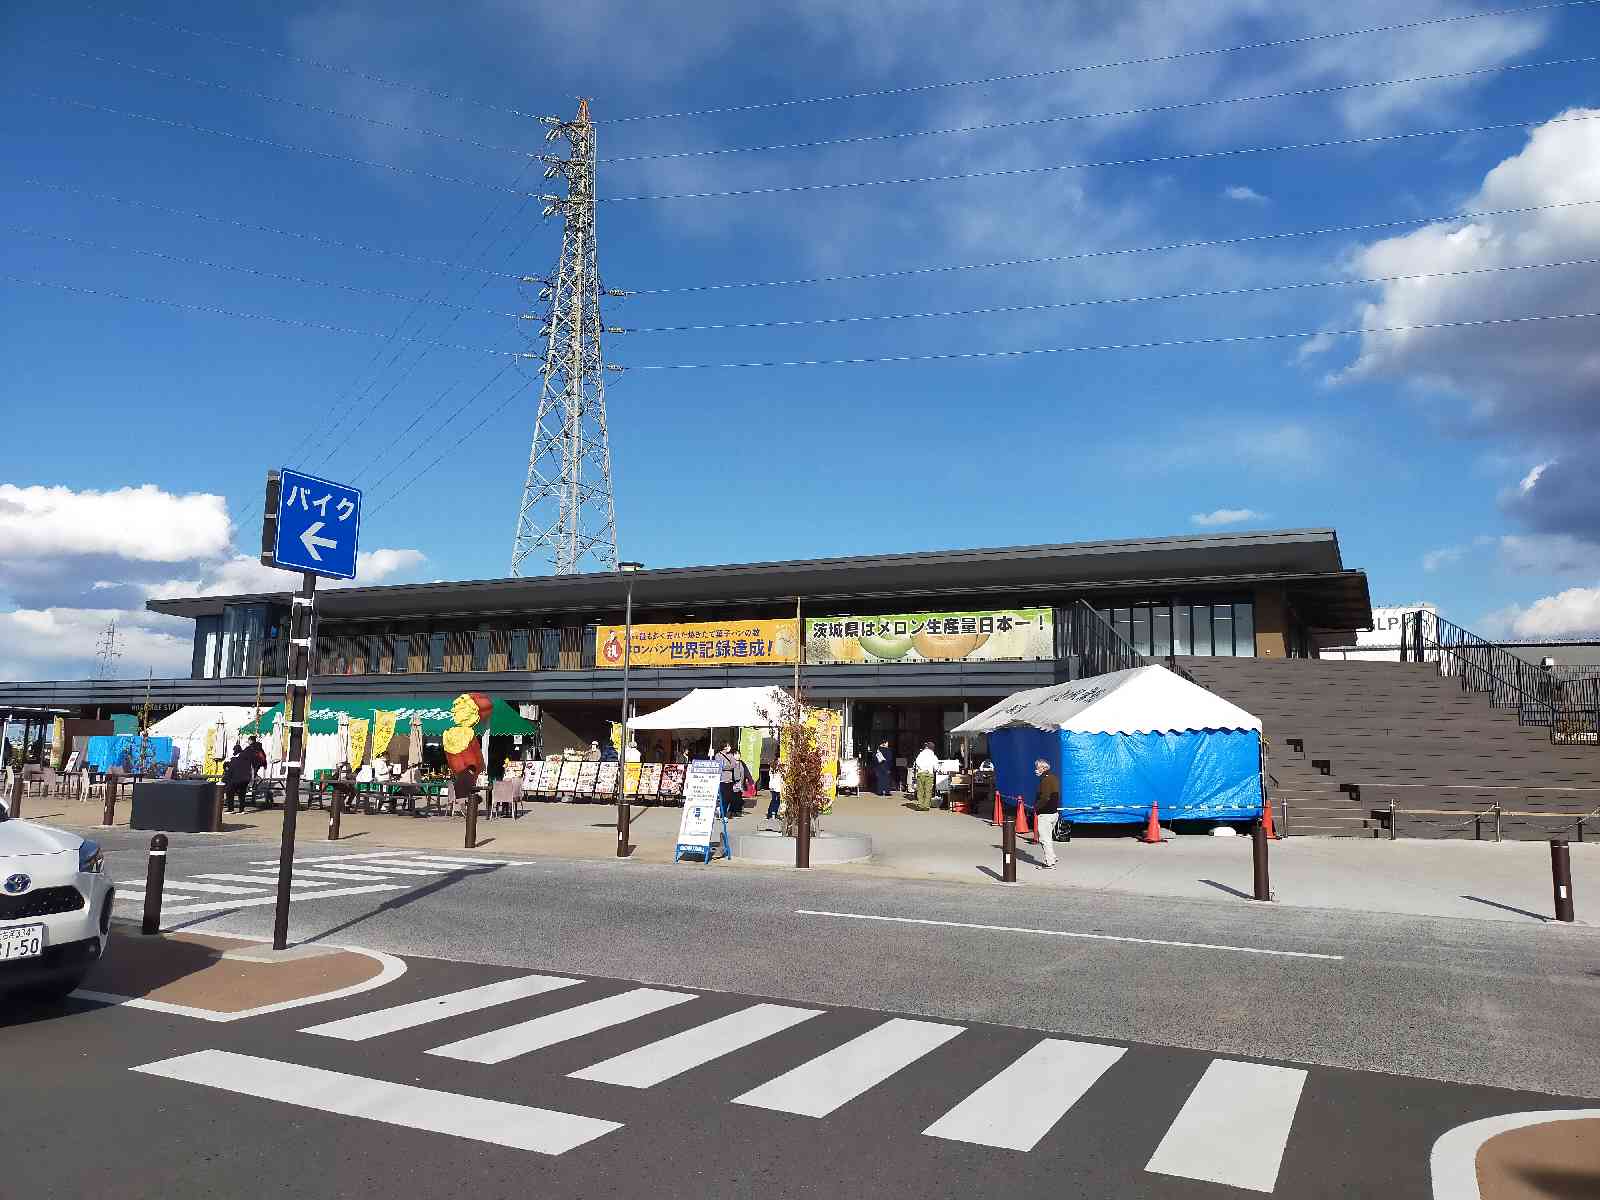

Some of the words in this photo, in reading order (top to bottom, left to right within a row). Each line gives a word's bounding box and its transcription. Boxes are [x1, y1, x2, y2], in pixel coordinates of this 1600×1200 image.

[286, 485, 354, 521] バイク
[813, 615, 1044, 638] 茨城県はメロン生産量日本一!
